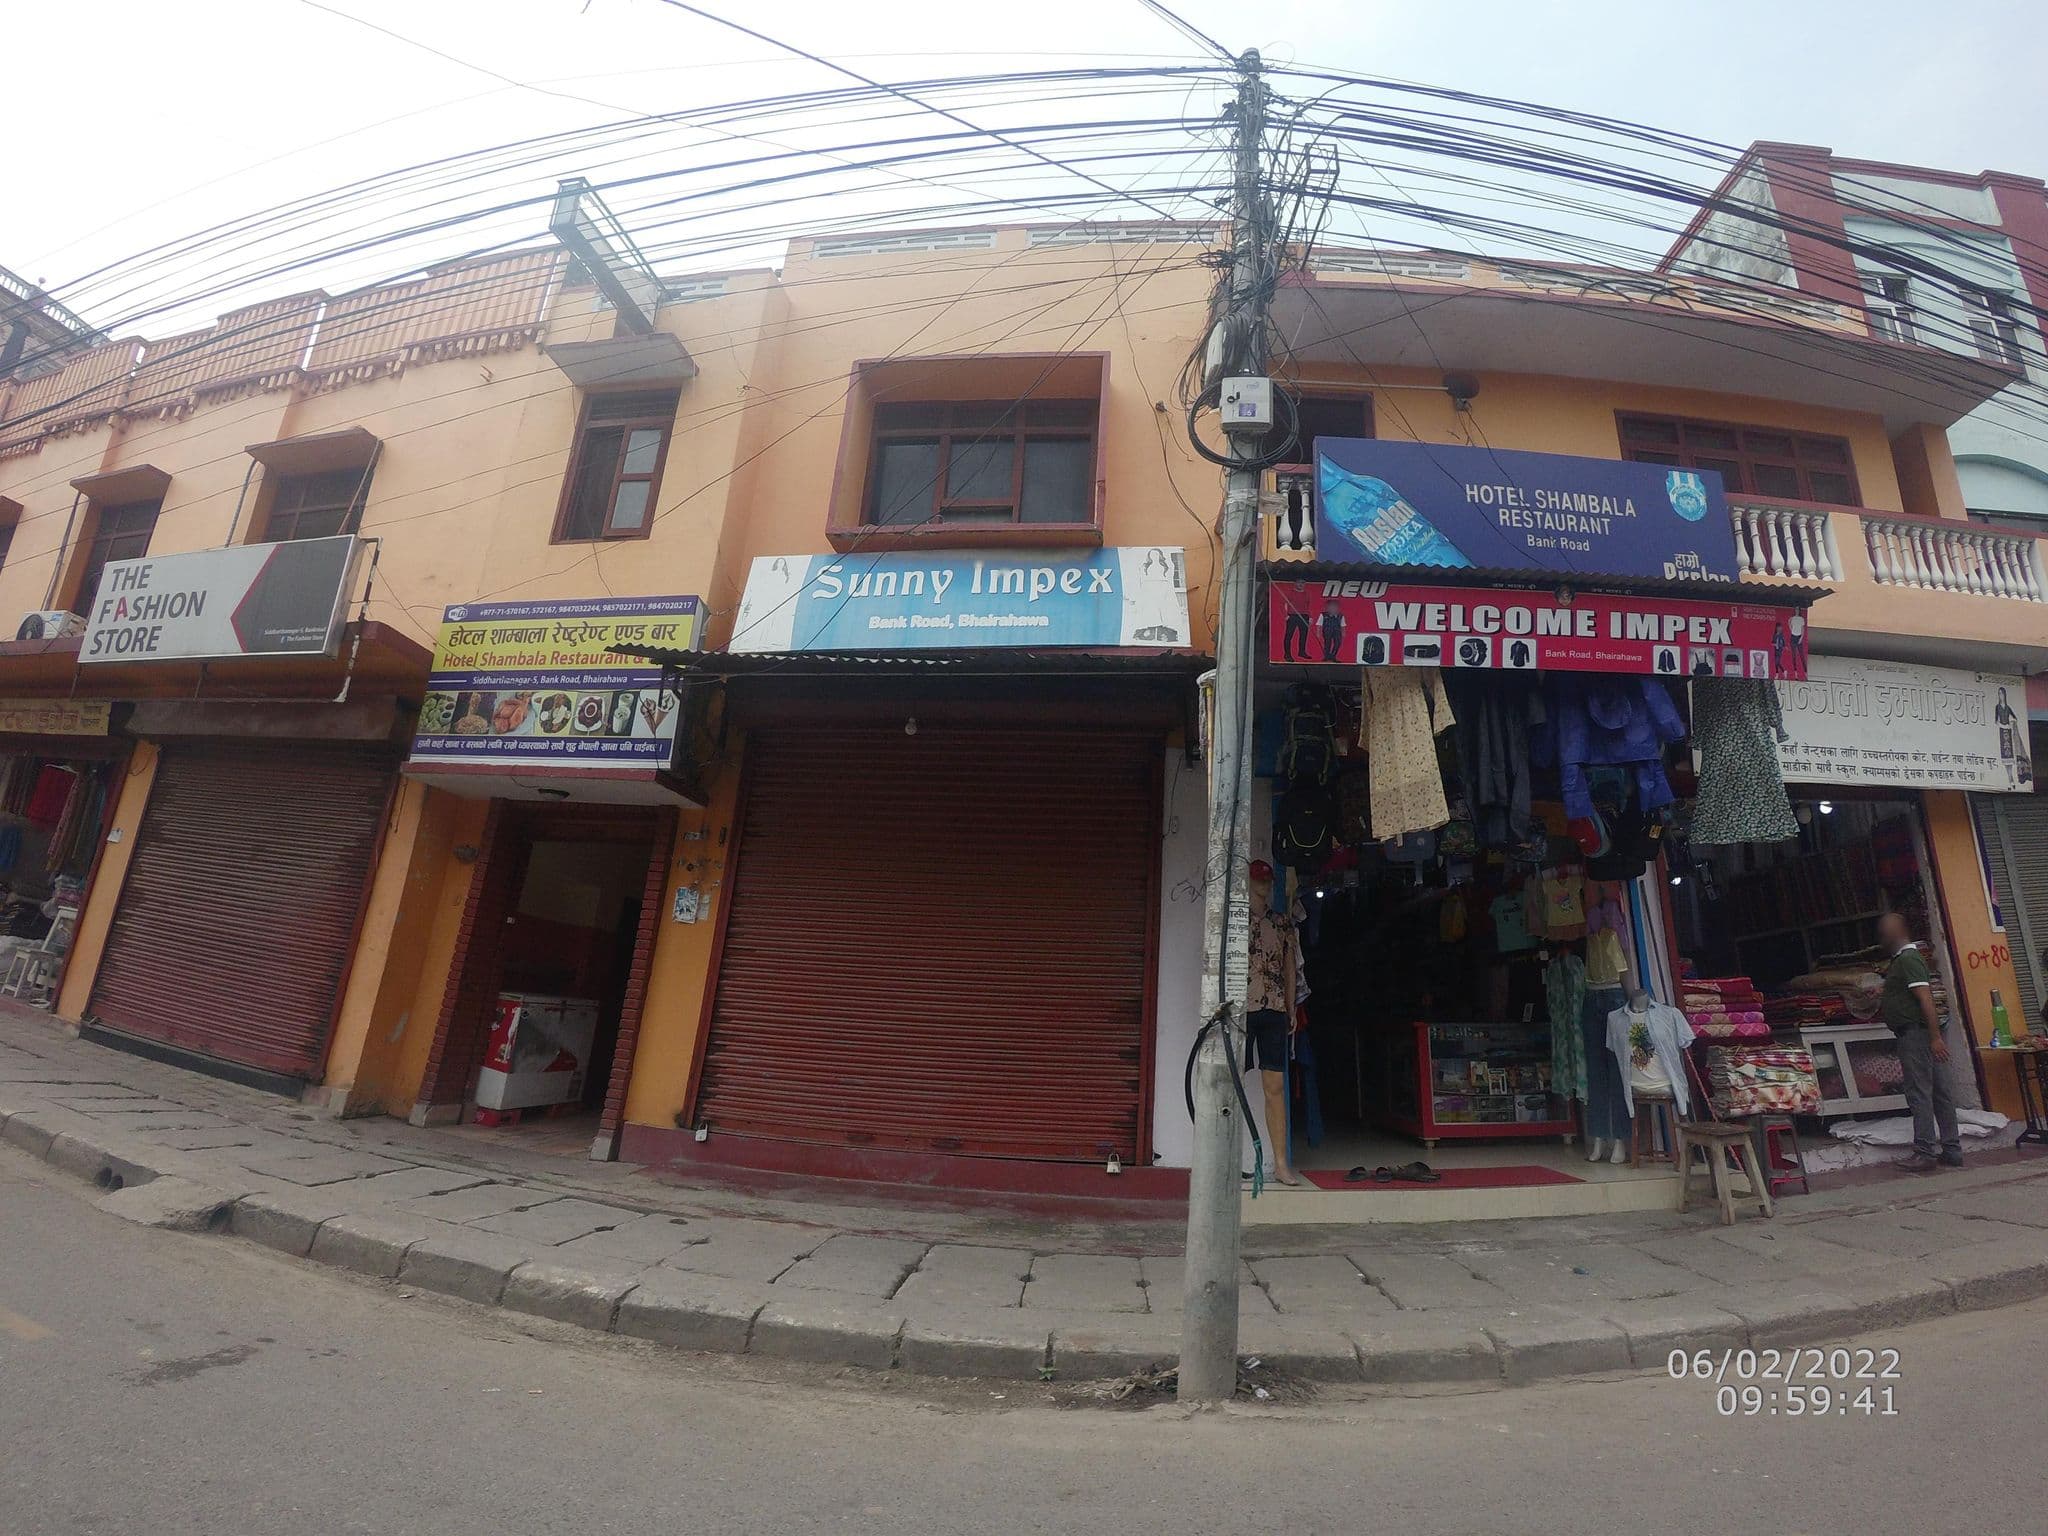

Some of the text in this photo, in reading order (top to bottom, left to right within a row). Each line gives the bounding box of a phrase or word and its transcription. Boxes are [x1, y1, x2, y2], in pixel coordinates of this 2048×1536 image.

[1466, 484, 1636, 517] HOTEL SHAMBALA
[1499, 509, 1611, 535] RESTAURANT
[1527, 534, 1590, 551] Bank Road
[111, 564, 153, 592] THE
[812, 560, 1114, 604] Sunny Impex
[98, 590, 207, 624] FASHION
[869, 615, 907, 629] Bank
[958, 613, 1049, 627] Bhairahawa
[1374, 601, 1597, 638] WELCOME
[1610, 611, 1732, 646] IMPEX
[89, 625, 162, 655] STORE
[449, 626, 487, 647] होटल
[490, 627, 549, 645] शाम्बाला
[614, 624, 648, 641] एण्ड
[651, 623, 680, 641] बार
[443, 652, 479, 667] Hotel
[480, 651, 547, 667] Shambala
[550, 649, 629, 665] Restaurant
[1545, 649, 1567, 658] Bank
[1595, 651, 1642, 662] Bhairahawa
[540, 675, 559, 684] Bank
[560, 675, 581, 685] Road,
[583, 675, 628, 684] Bhairahawa
